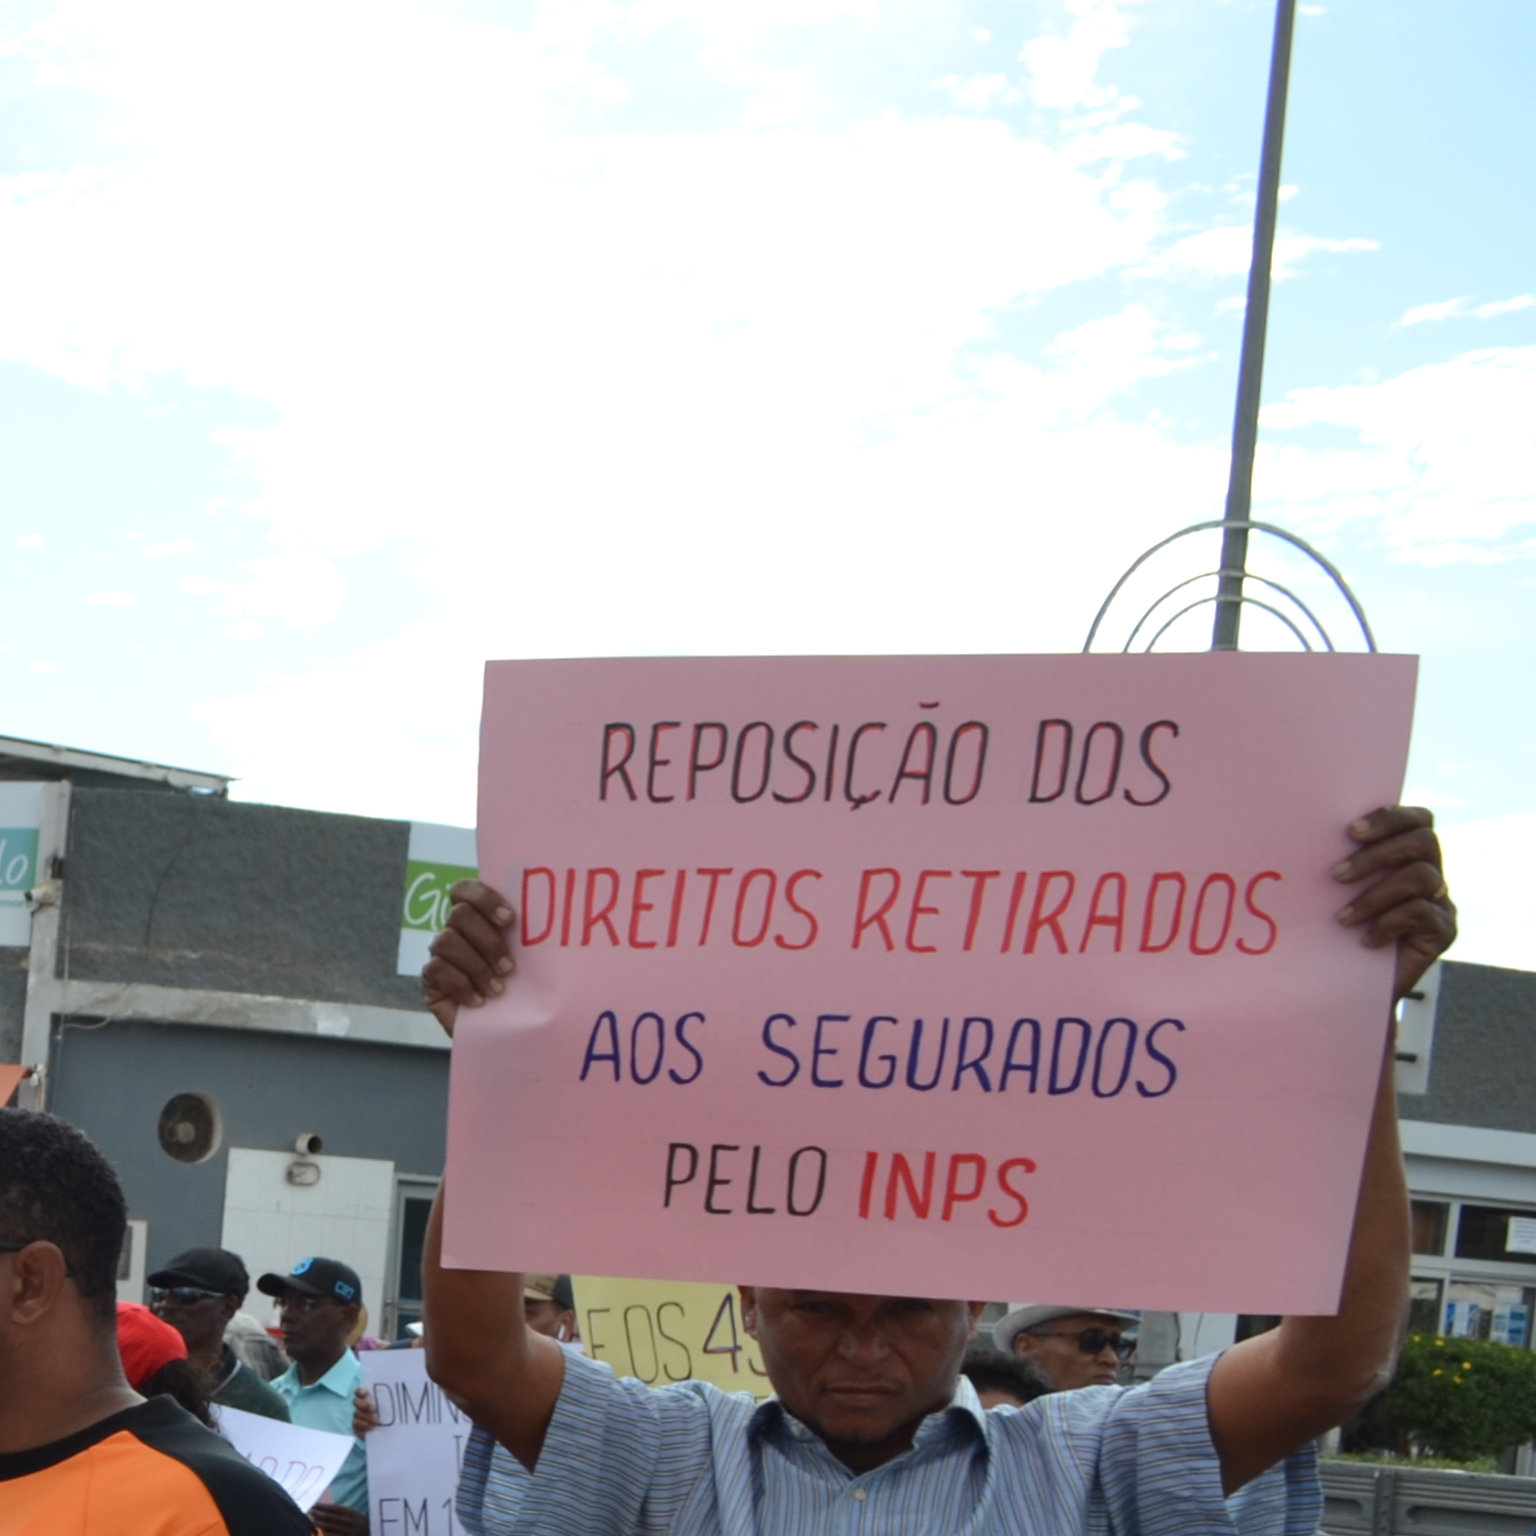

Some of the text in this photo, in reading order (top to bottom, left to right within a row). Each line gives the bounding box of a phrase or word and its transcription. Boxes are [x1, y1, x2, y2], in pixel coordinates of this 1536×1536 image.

[598, 701, 1180, 811] REPOSIÇÃO DOS
[519, 865, 1283, 957] DIREITOS RETIRADOS
[579, 1009, 1186, 1098] AOS SEGURADOS
[663, 1142, 1038, 1229] PELO INPS
[373, 1381, 473, 1427] DIMIN
